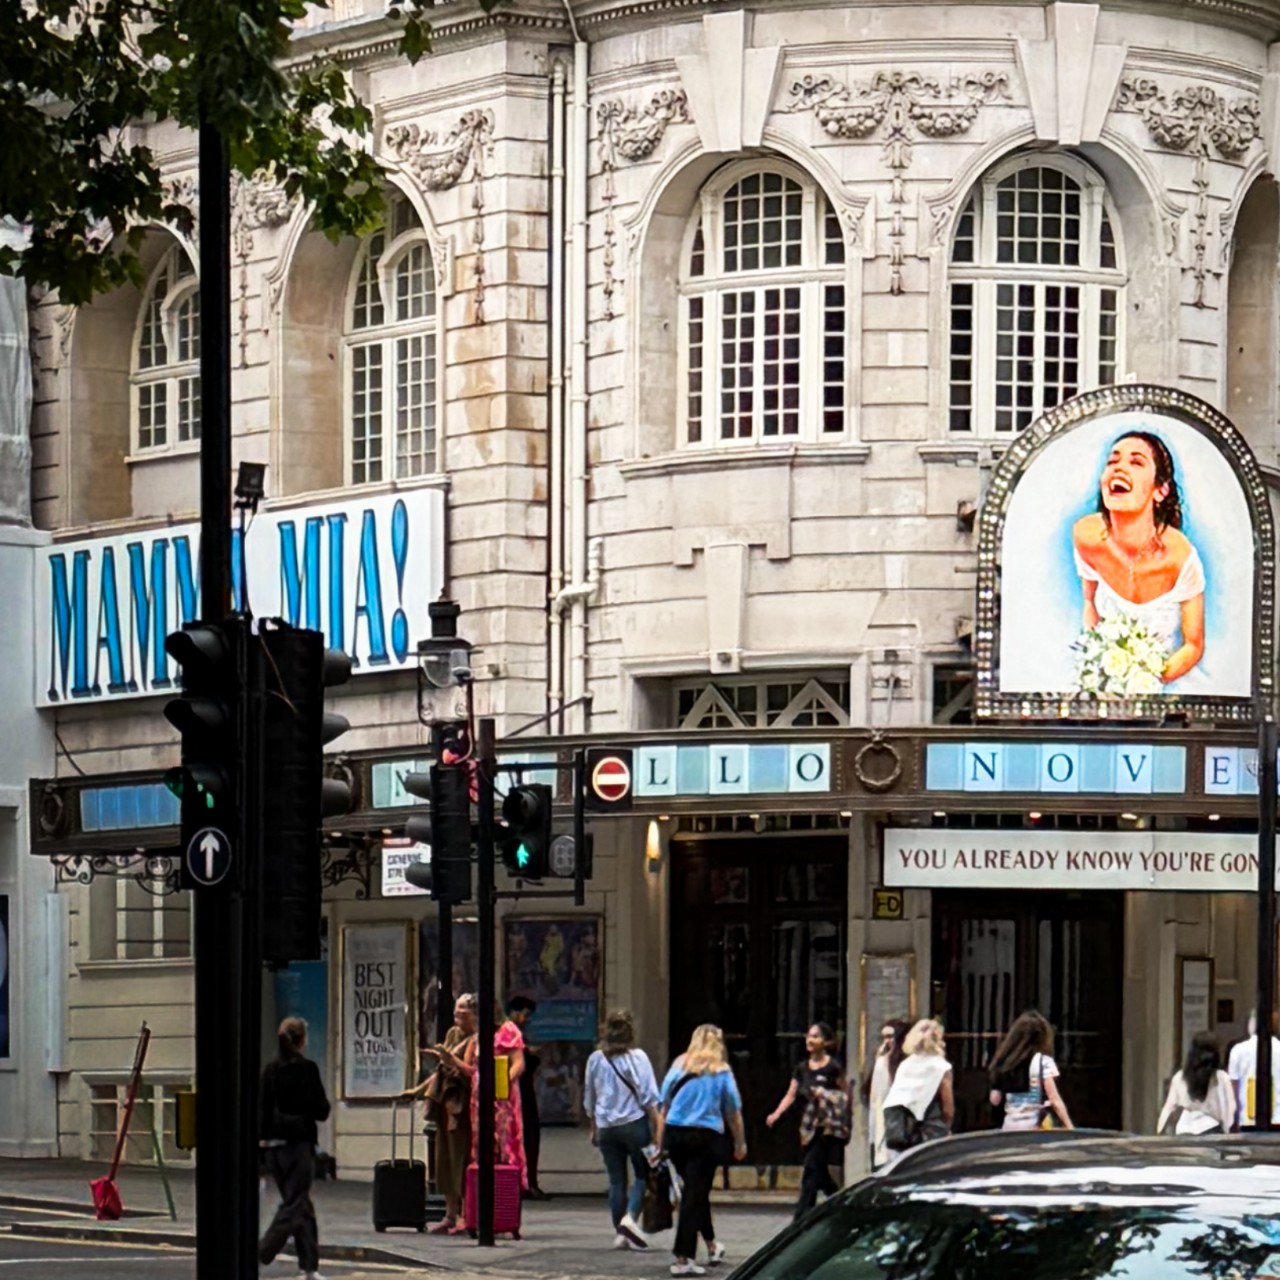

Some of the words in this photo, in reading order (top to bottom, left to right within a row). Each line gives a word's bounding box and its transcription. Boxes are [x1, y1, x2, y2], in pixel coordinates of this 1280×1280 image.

[277, 498, 409, 668] MIA!
[899, 849, 946, 869] YOU
[953, 849, 1058, 870] ALREADY
[1066, 851, 1133, 870] KNOW
[1139, 851, 1214, 872] YOU'RE
[354, 962, 397, 988] BEST
[354, 988, 395, 1010] NIGHT
[355, 1009, 396, 1038] OUT
